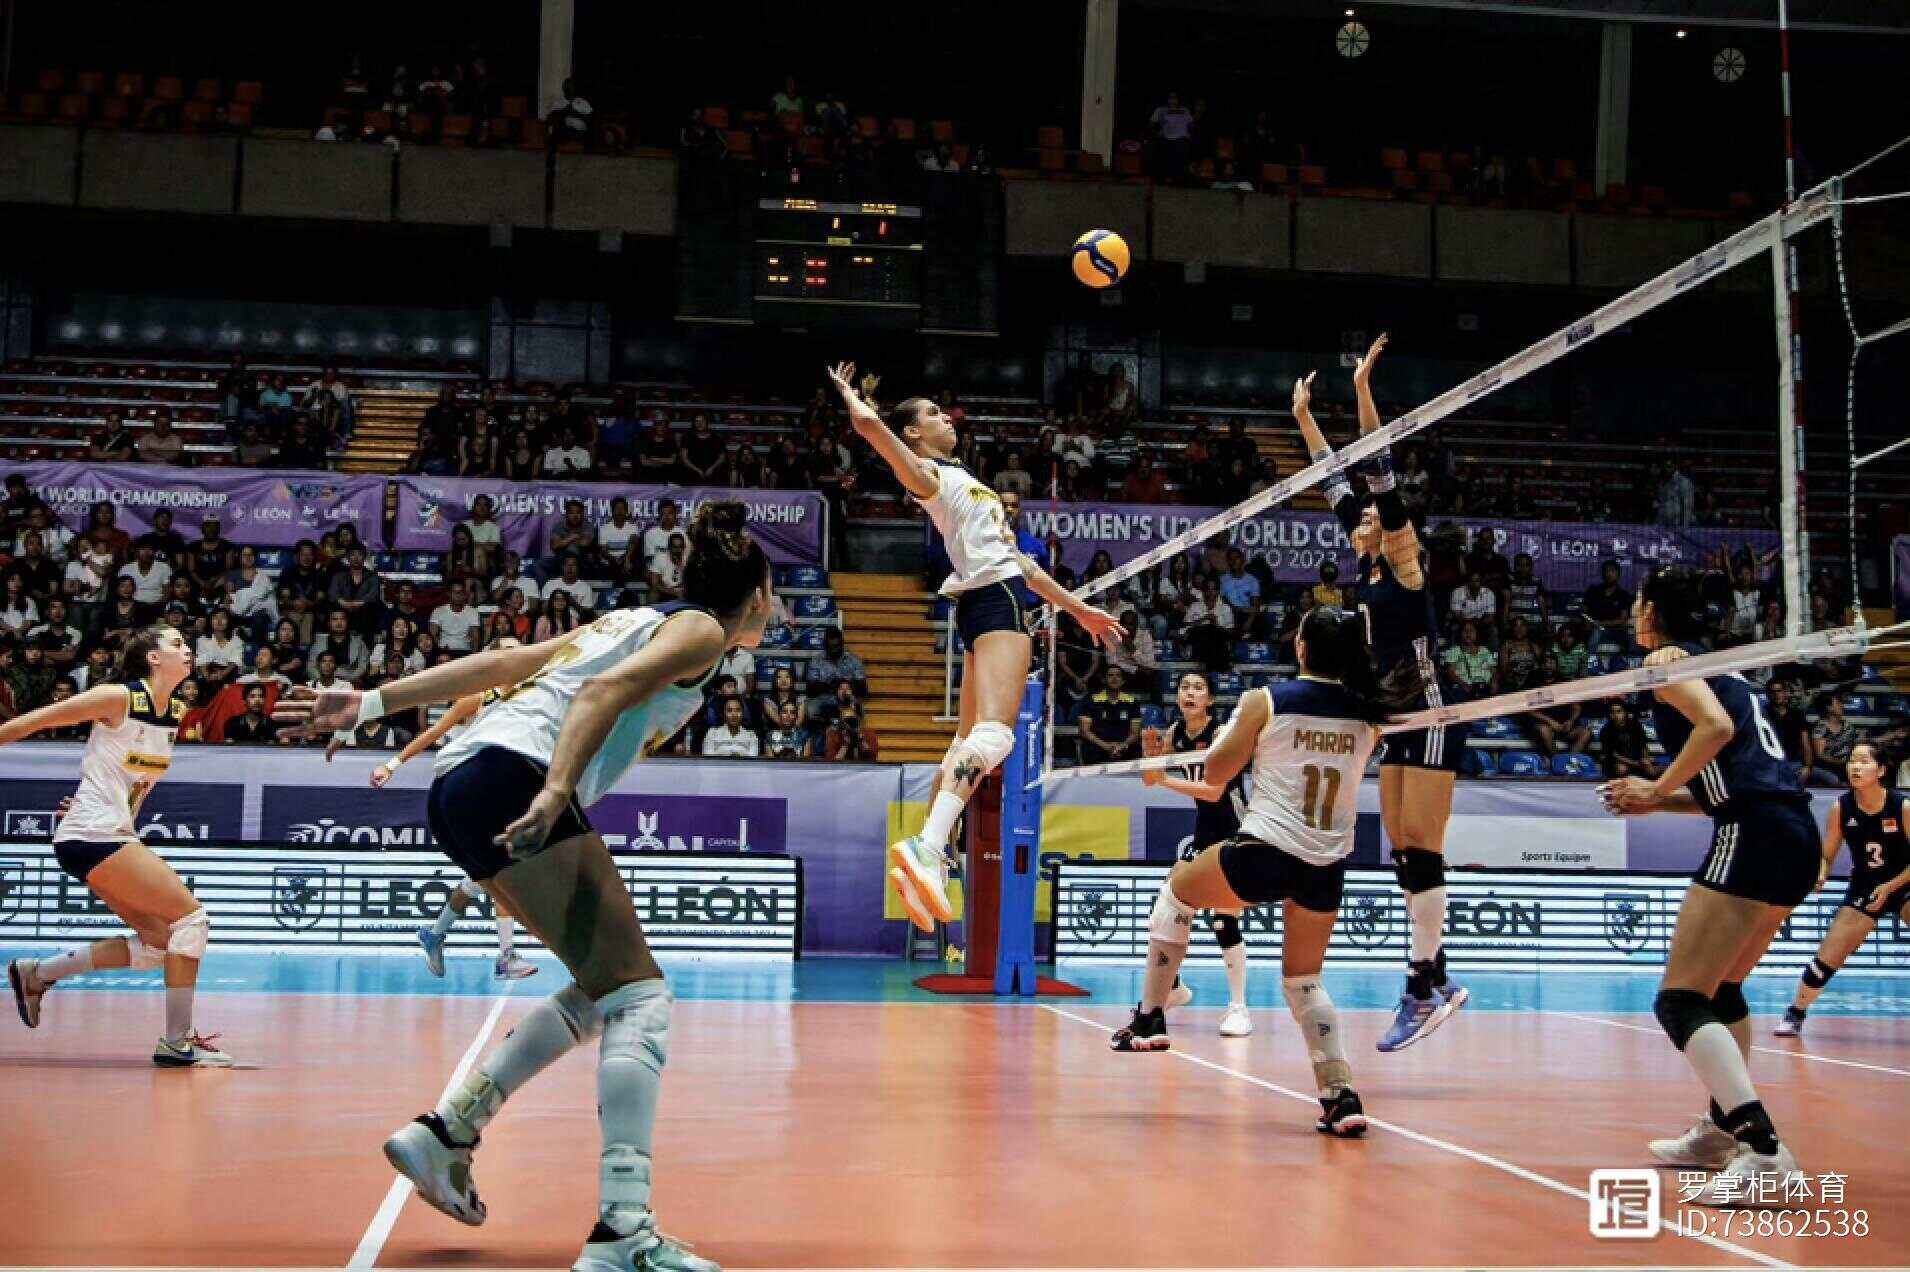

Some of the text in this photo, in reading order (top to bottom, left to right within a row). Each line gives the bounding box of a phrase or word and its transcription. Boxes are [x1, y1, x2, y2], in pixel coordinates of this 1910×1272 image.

[1025, 510, 1151, 541] WOMEN'S
[1293, 729, 1355, 756] MARIA
[1302, 763, 1342, 831] 11
[1866, 842, 1885, 868] 3
[649, 874, 780, 924] LEÓN
[1447, 890, 1542, 938] EÓN
